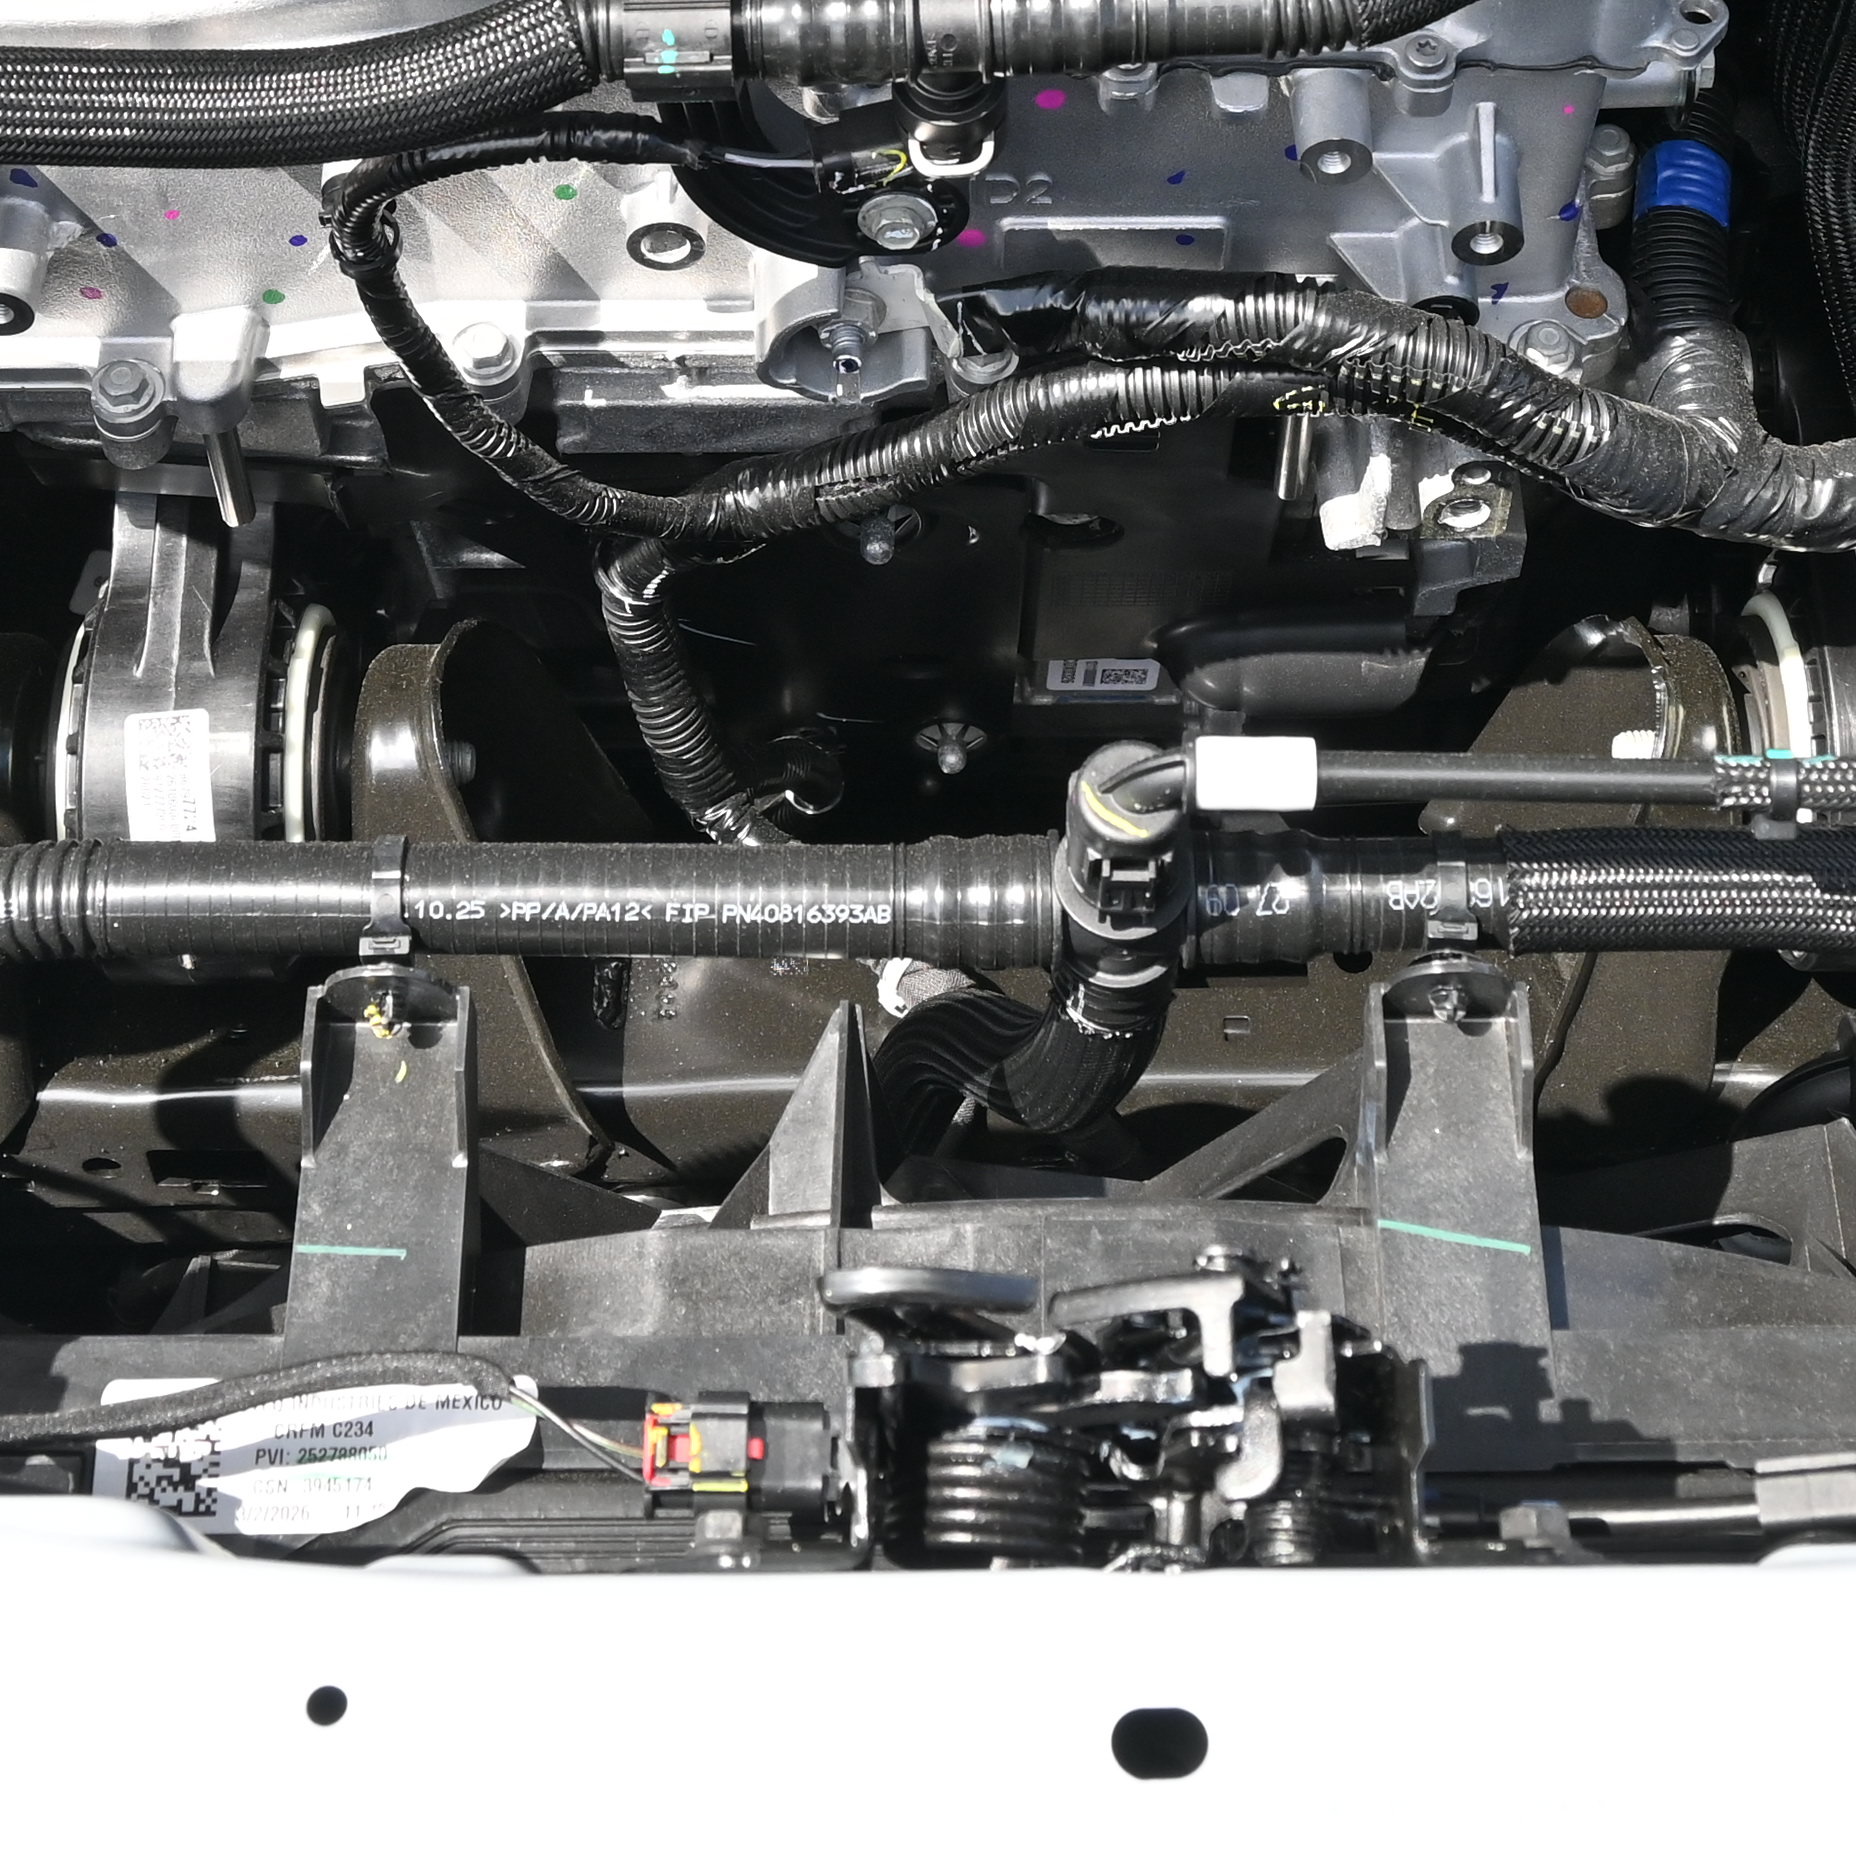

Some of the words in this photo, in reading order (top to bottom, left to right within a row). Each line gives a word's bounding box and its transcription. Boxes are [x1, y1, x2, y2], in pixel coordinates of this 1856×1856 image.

[499, 902, 652, 923] >PP/A/PA12<
[664, 903, 711, 922] FIP
[435, 1394, 504, 1412] MEXICO
[331, 1420, 375, 1439] C234
[254, 1447, 291, 1466] PVI:
